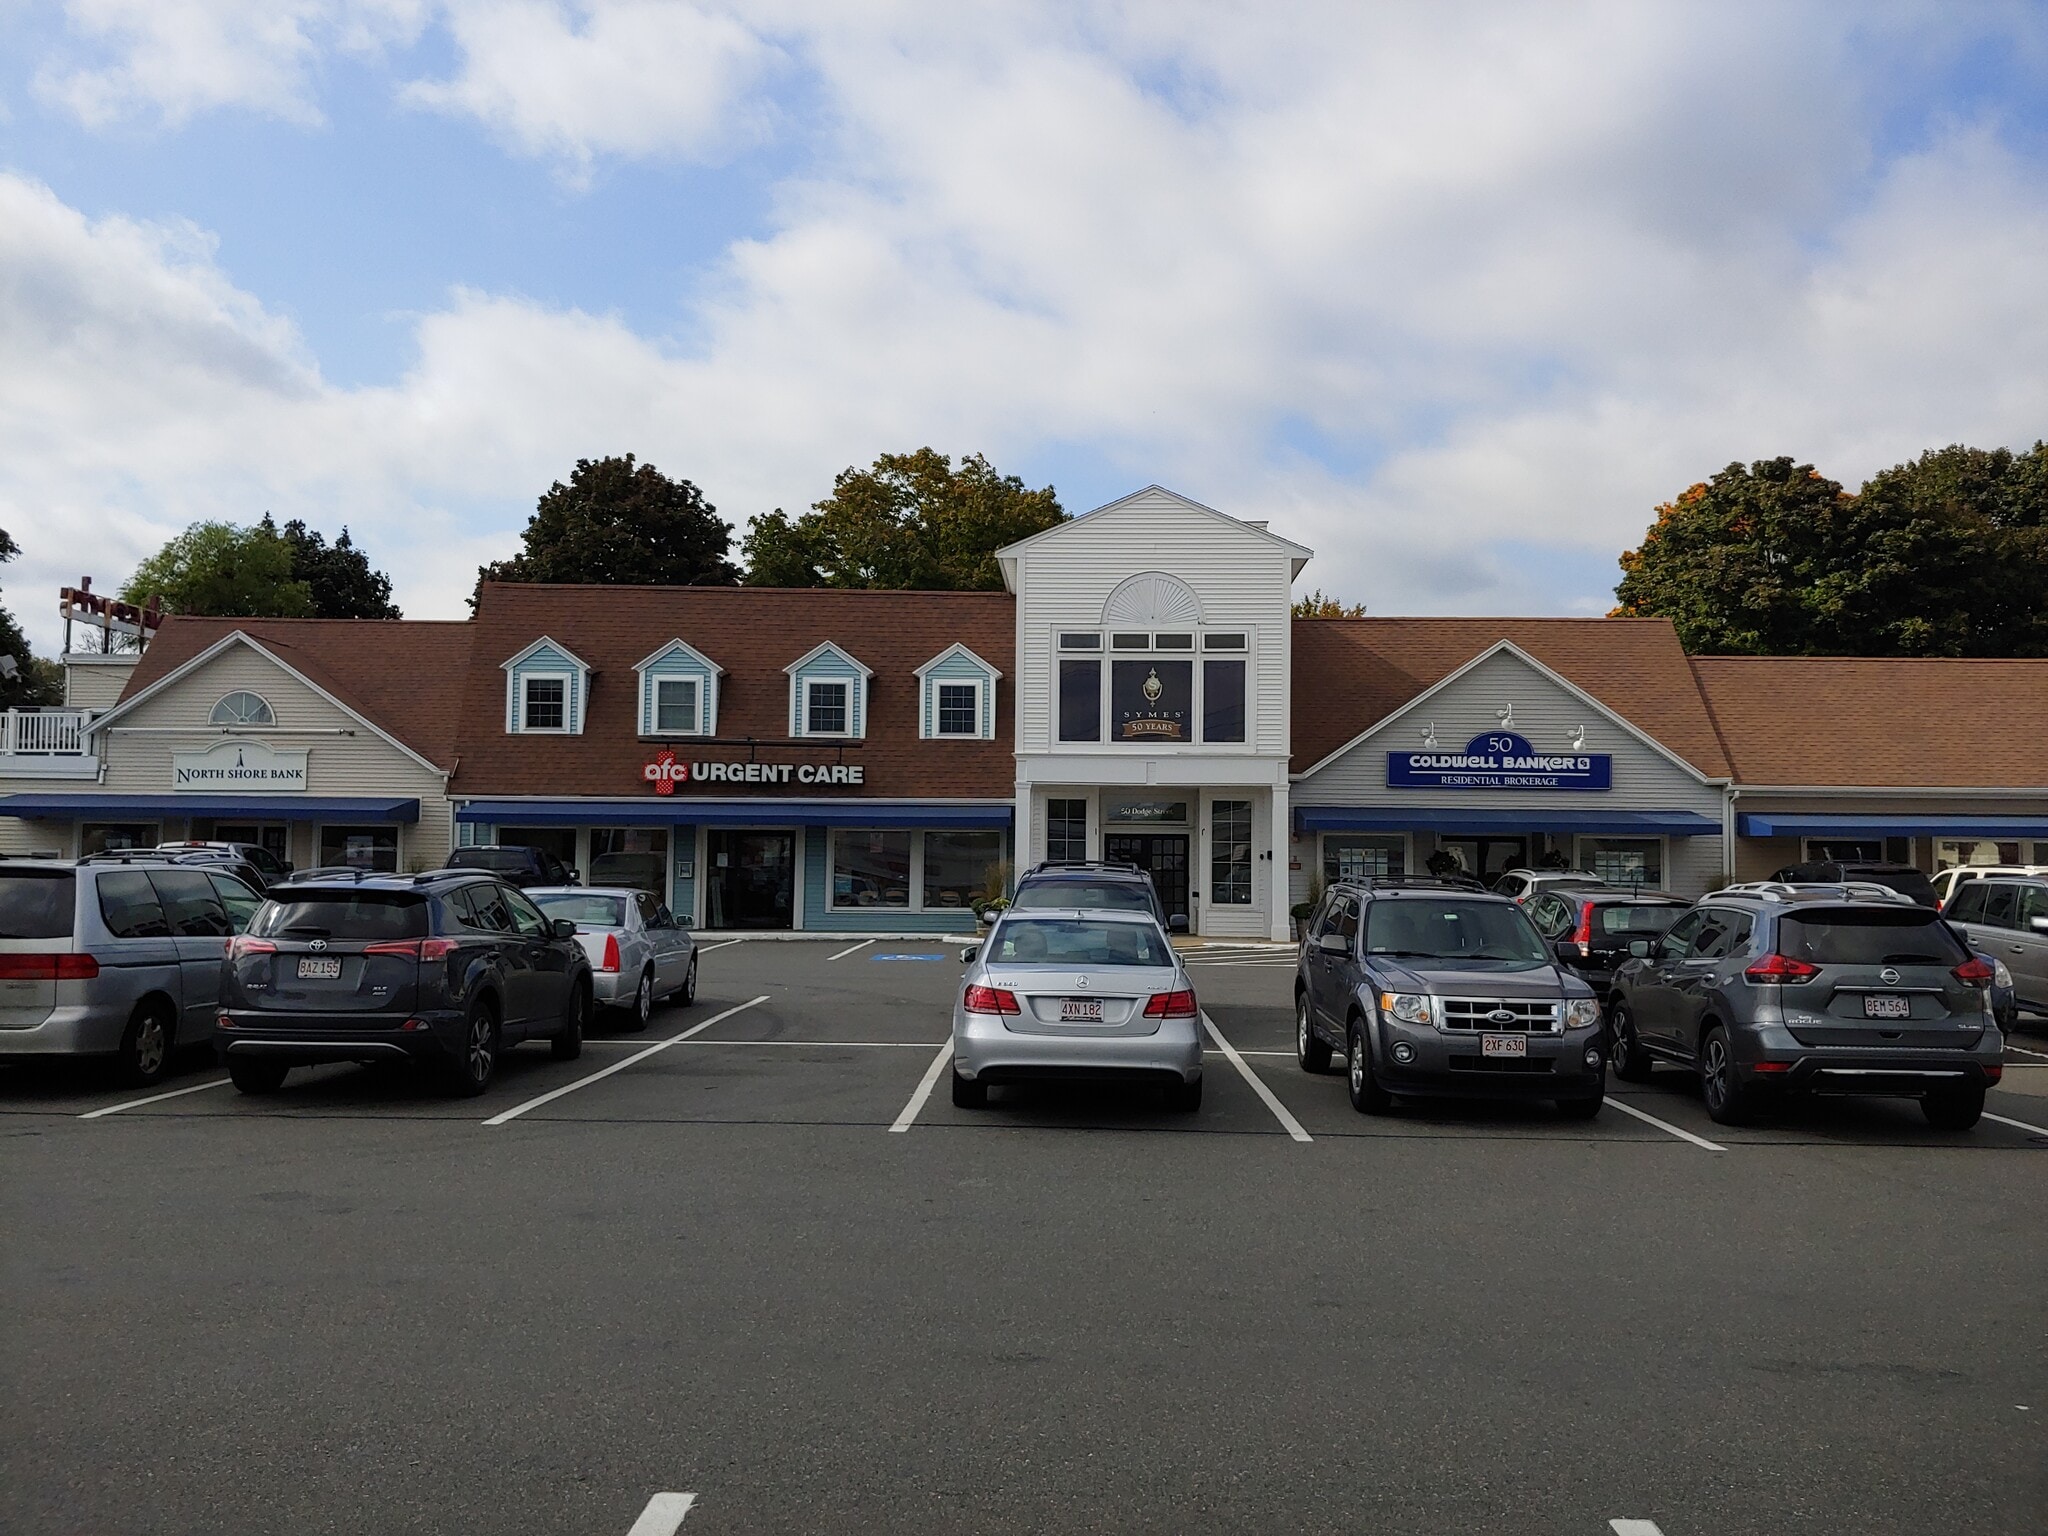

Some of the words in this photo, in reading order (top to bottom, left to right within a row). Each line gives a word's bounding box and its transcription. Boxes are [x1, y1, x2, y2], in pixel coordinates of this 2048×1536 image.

[1132, 723, 1143, 731] 50
[1145, 723, 1173, 731] YEARS
[1487, 737, 1513, 752] 50
[1409, 755, 1499, 769] COLDWELL
[1502, 756, 1575, 771] BANKER
[177, 768, 224, 783] NORTH
[227, 769, 268, 779] SHORE
[270, 769, 303, 779] BANK
[645, 757, 687, 781] afc
[692, 763, 794, 783] URGENT
[798, 765, 864, 784] CARE
[1441, 776, 1501, 785] RESIDENTIAL
[1504, 776, 1559, 786] BROKERAGE
[1121, 807, 1131, 815] 50
[1132, 807, 1152, 817] Dodge
[300, 962, 319, 974] 8AZ
[320, 962, 339, 974] 155
[1061, 1003, 1081, 1015] 4XN
[1083, 1003, 1101, 1016] 182
[1866, 1000, 1886, 1012] 8EM
[1888, 1000, 1908, 1012] 564
[1485, 1039, 1503, 1051] 2XF
[1506, 1040, 1525, 1052] 630
